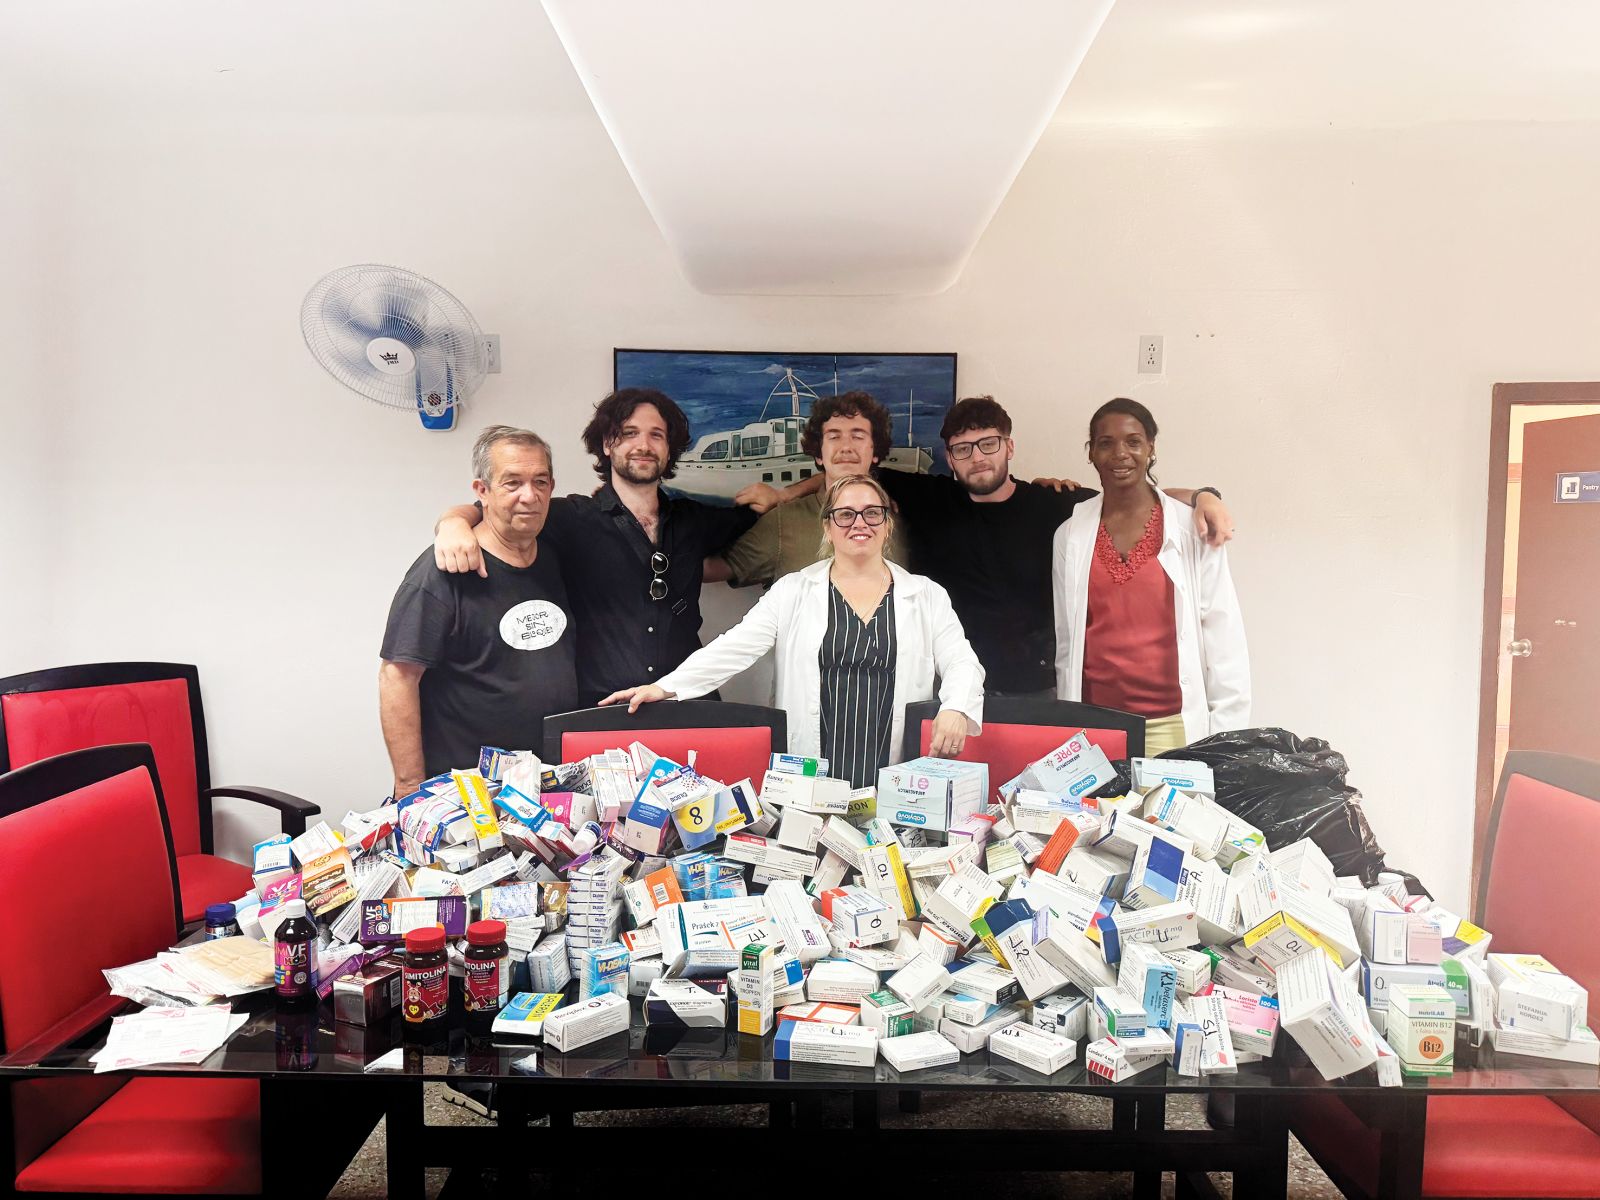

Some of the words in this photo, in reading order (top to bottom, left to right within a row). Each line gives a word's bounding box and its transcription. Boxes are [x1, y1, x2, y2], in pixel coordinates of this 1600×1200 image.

[1071, 776, 1096, 796] babylove
[689, 806, 703, 825] 8
[897, 811, 926, 824] babylove
[940, 920, 968, 943] Ranexa
[287, 943, 306, 957] VF
[1160, 986, 1172, 1019] betaserc
[1439, 1021, 1453, 1029] B12
[1422, 1041, 1442, 1053] B12
